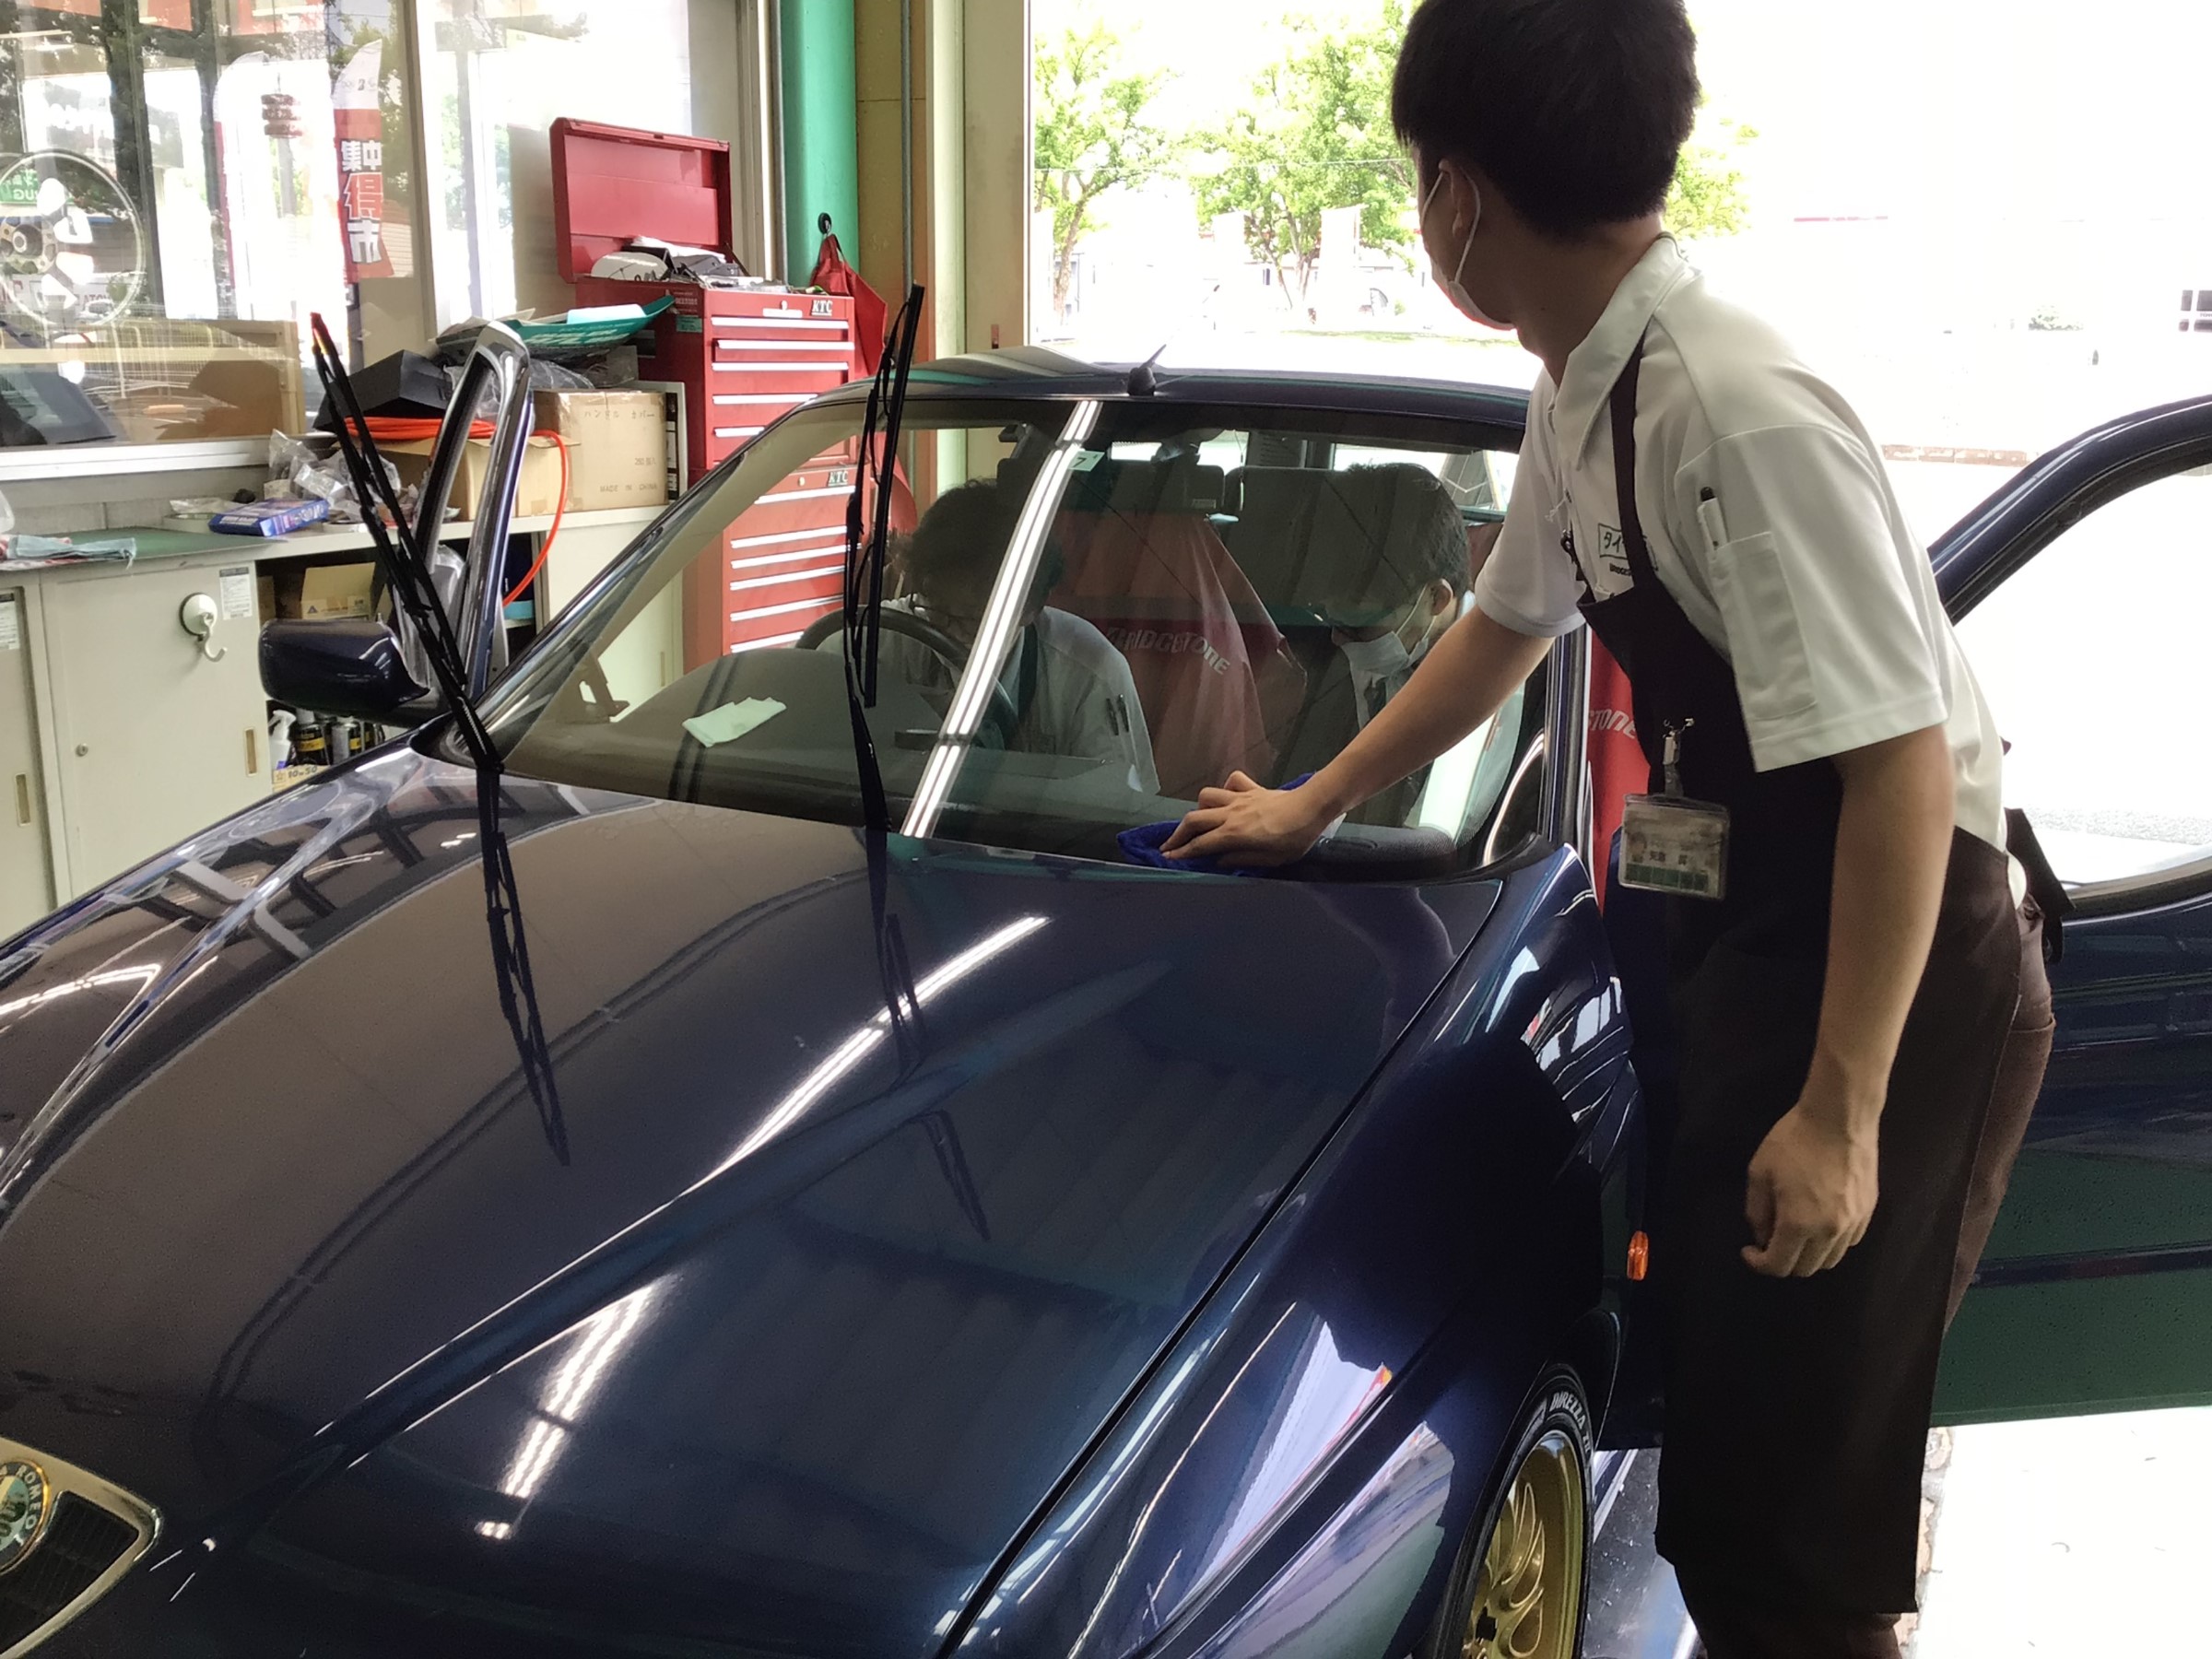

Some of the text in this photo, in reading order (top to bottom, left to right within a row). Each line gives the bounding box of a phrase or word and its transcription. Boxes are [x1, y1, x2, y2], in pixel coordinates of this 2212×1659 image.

[811, 300, 833, 316] KTC
[828, 470, 849, 486] KTC
[1549, 1391, 1586, 1430] DIREZZA
[16, 1465, 41, 1530] ROMEO
